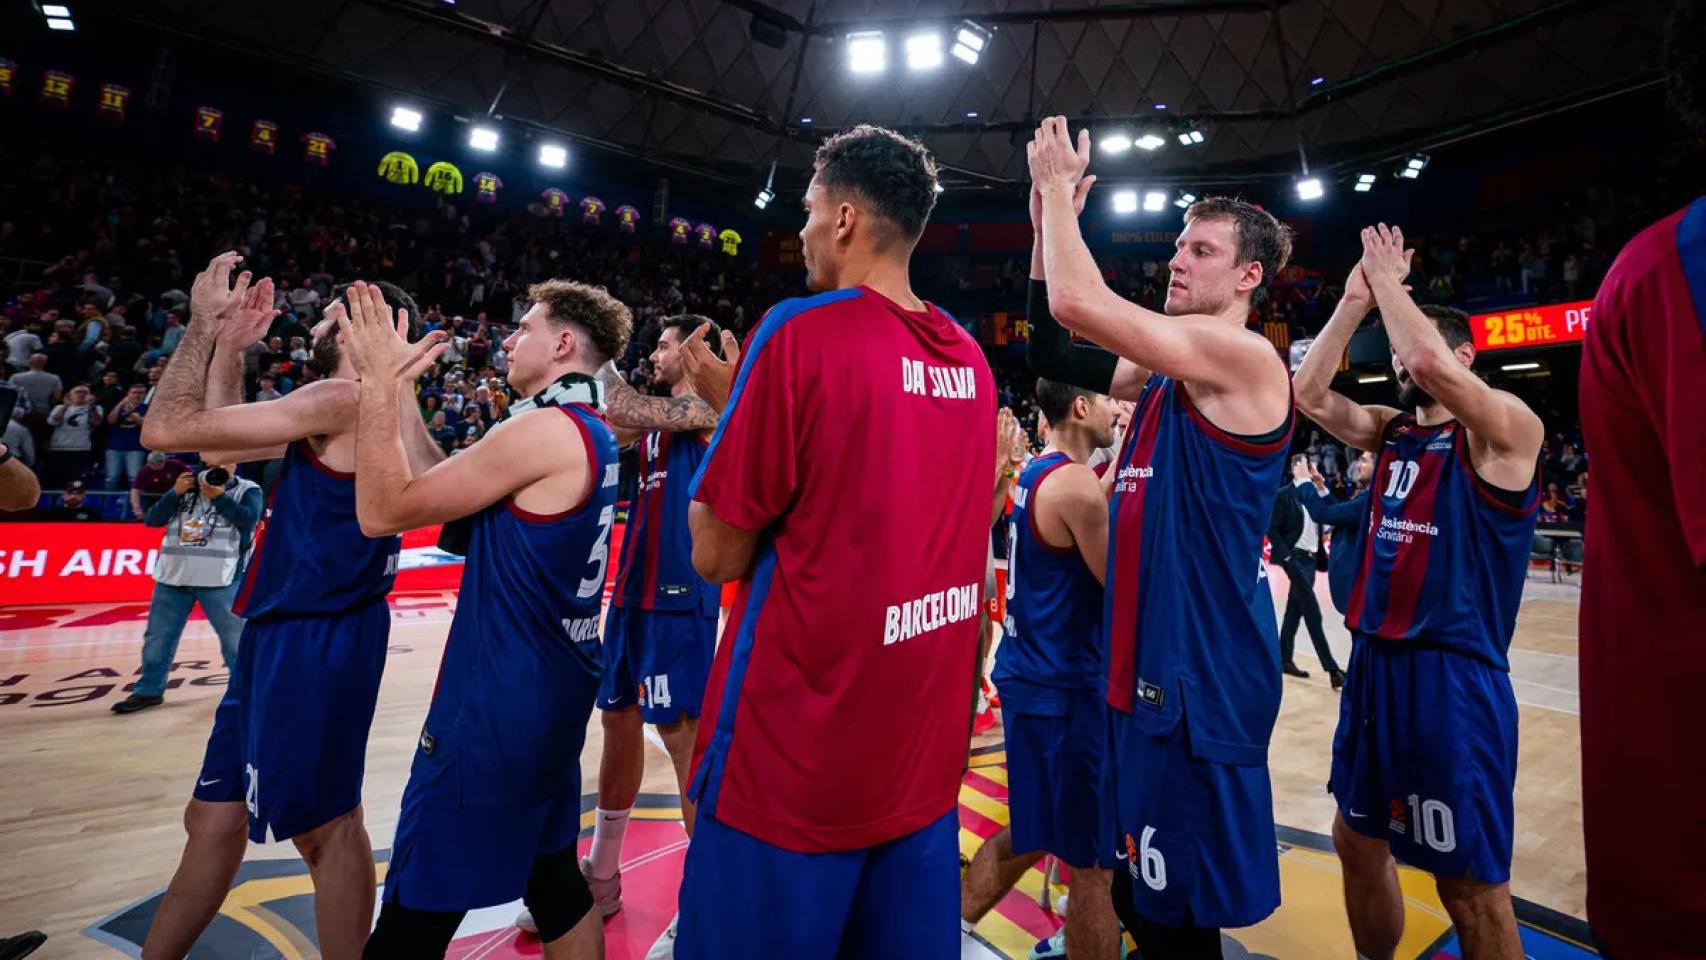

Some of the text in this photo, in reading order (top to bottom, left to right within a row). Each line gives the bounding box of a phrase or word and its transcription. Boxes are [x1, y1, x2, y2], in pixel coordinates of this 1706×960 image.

[202, 115, 214, 129] 7
[901, 356, 976, 399] DA SILVA
[1383, 459, 1420, 500] 10
[883, 582, 979, 646] BARCELONA
[643, 673, 672, 709] 14
[1407, 792, 1457, 853] 10
[1140, 824, 1168, 891] 6
